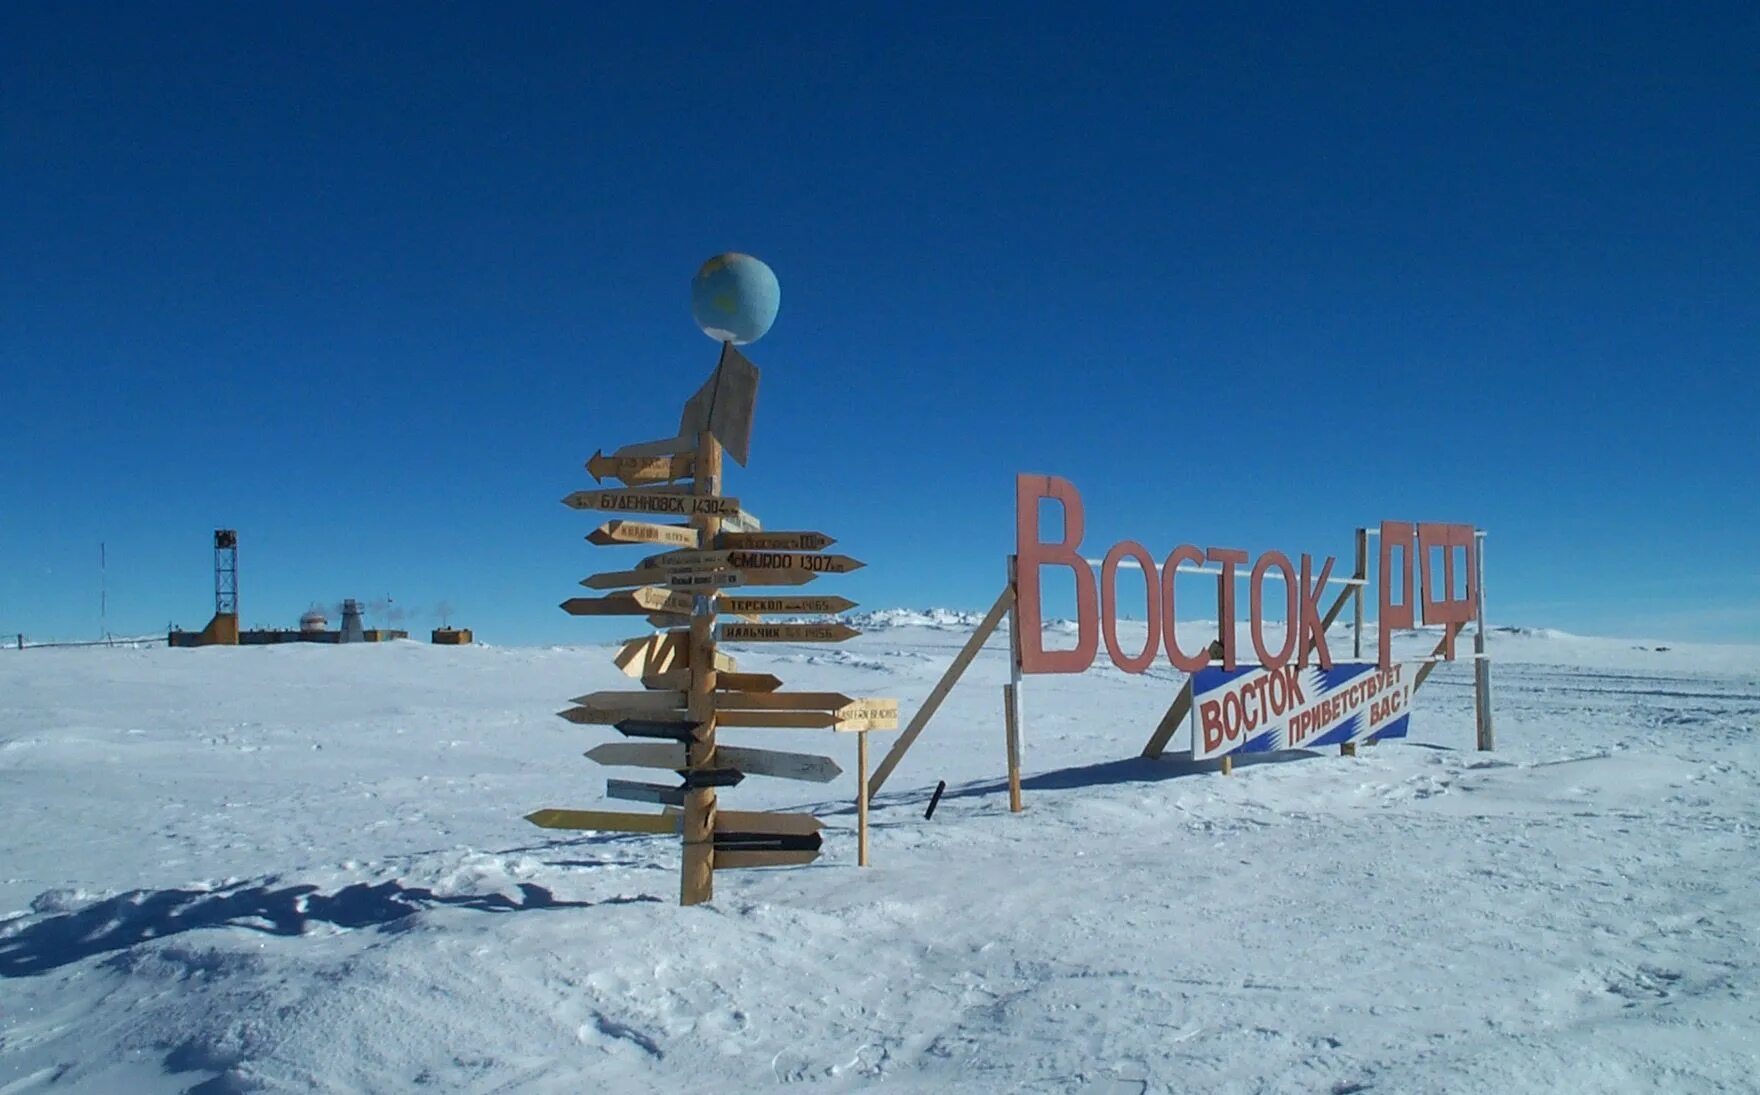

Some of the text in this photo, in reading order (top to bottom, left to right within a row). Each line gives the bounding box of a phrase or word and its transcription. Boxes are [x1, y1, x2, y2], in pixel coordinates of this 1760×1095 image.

[800, 554, 832, 571] 1307
[1379, 519, 1477, 671] РФ
[726, 627, 780, 638] НАЛЬЧИК
[1200, 665, 1305, 754] ВОСТОК
[1289, 663, 1402, 748] ПРИВЕТСТВУЕТ
